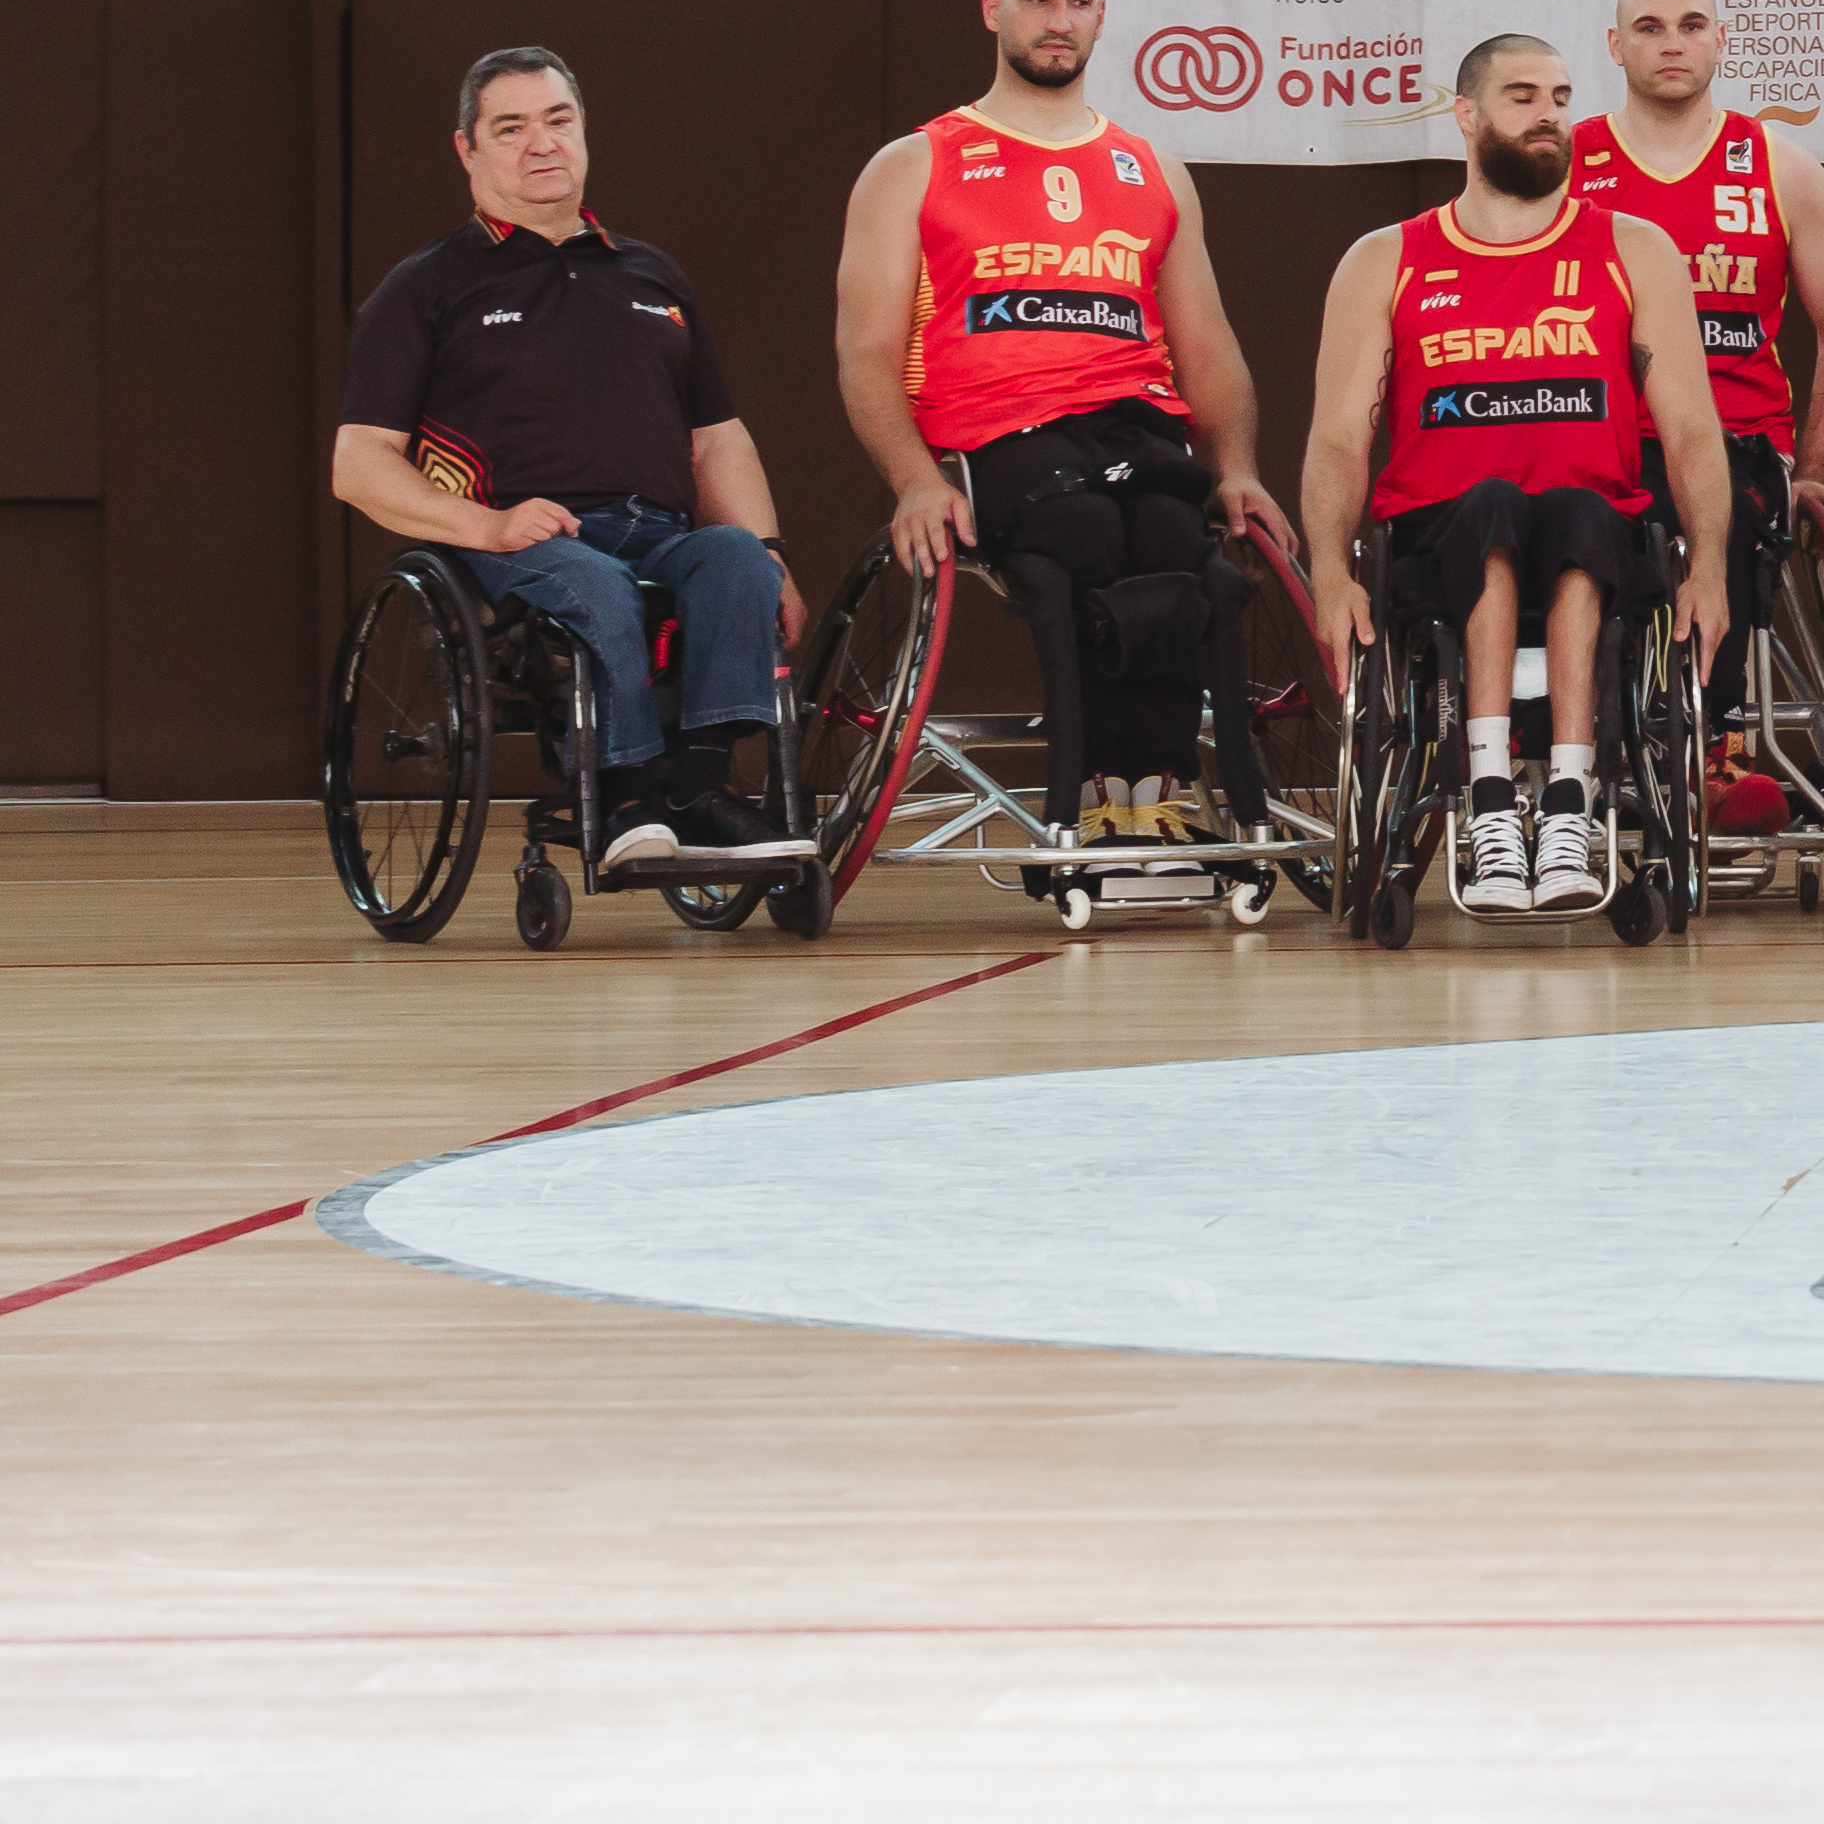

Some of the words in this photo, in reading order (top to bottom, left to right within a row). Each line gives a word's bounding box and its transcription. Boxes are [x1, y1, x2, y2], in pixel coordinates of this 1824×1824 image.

[1279, 32, 1424, 60] Fundación
[1277, 63, 1424, 108] ONCE
[1749, 78, 1822, 102] FÍSICA
[1042, 164, 1083, 224] 9
[1712, 183, 1771, 236] 51
[972, 228, 1152, 288] ESPAÑA
[1552, 259, 1581, 298] 11
[1016, 296, 1139, 335] CaixaBank
[1418, 305, 1600, 368] ESPAÑA
[1464, 387, 1594, 419] CaixaBank
